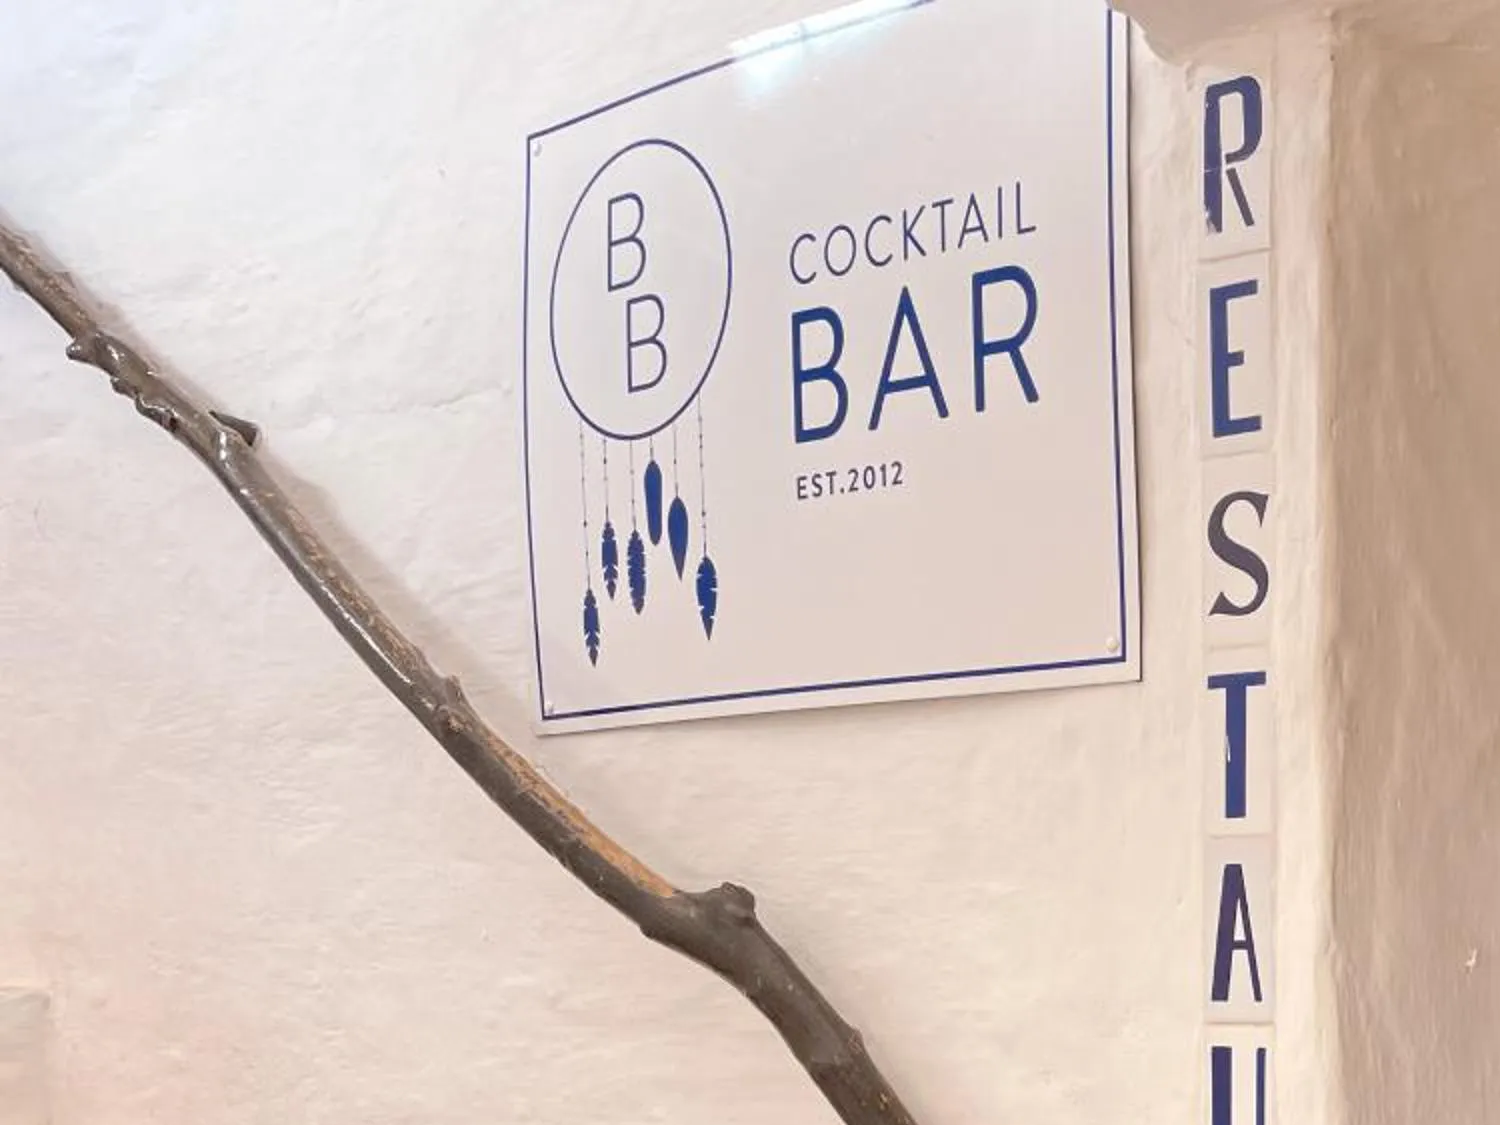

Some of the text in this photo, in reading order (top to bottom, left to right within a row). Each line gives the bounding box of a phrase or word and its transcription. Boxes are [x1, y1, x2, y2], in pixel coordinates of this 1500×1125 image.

[789, 181, 1037, 285] COCKTAIL
[791, 264, 1040, 444] BAR
[796, 460, 904, 500] EST.2012
